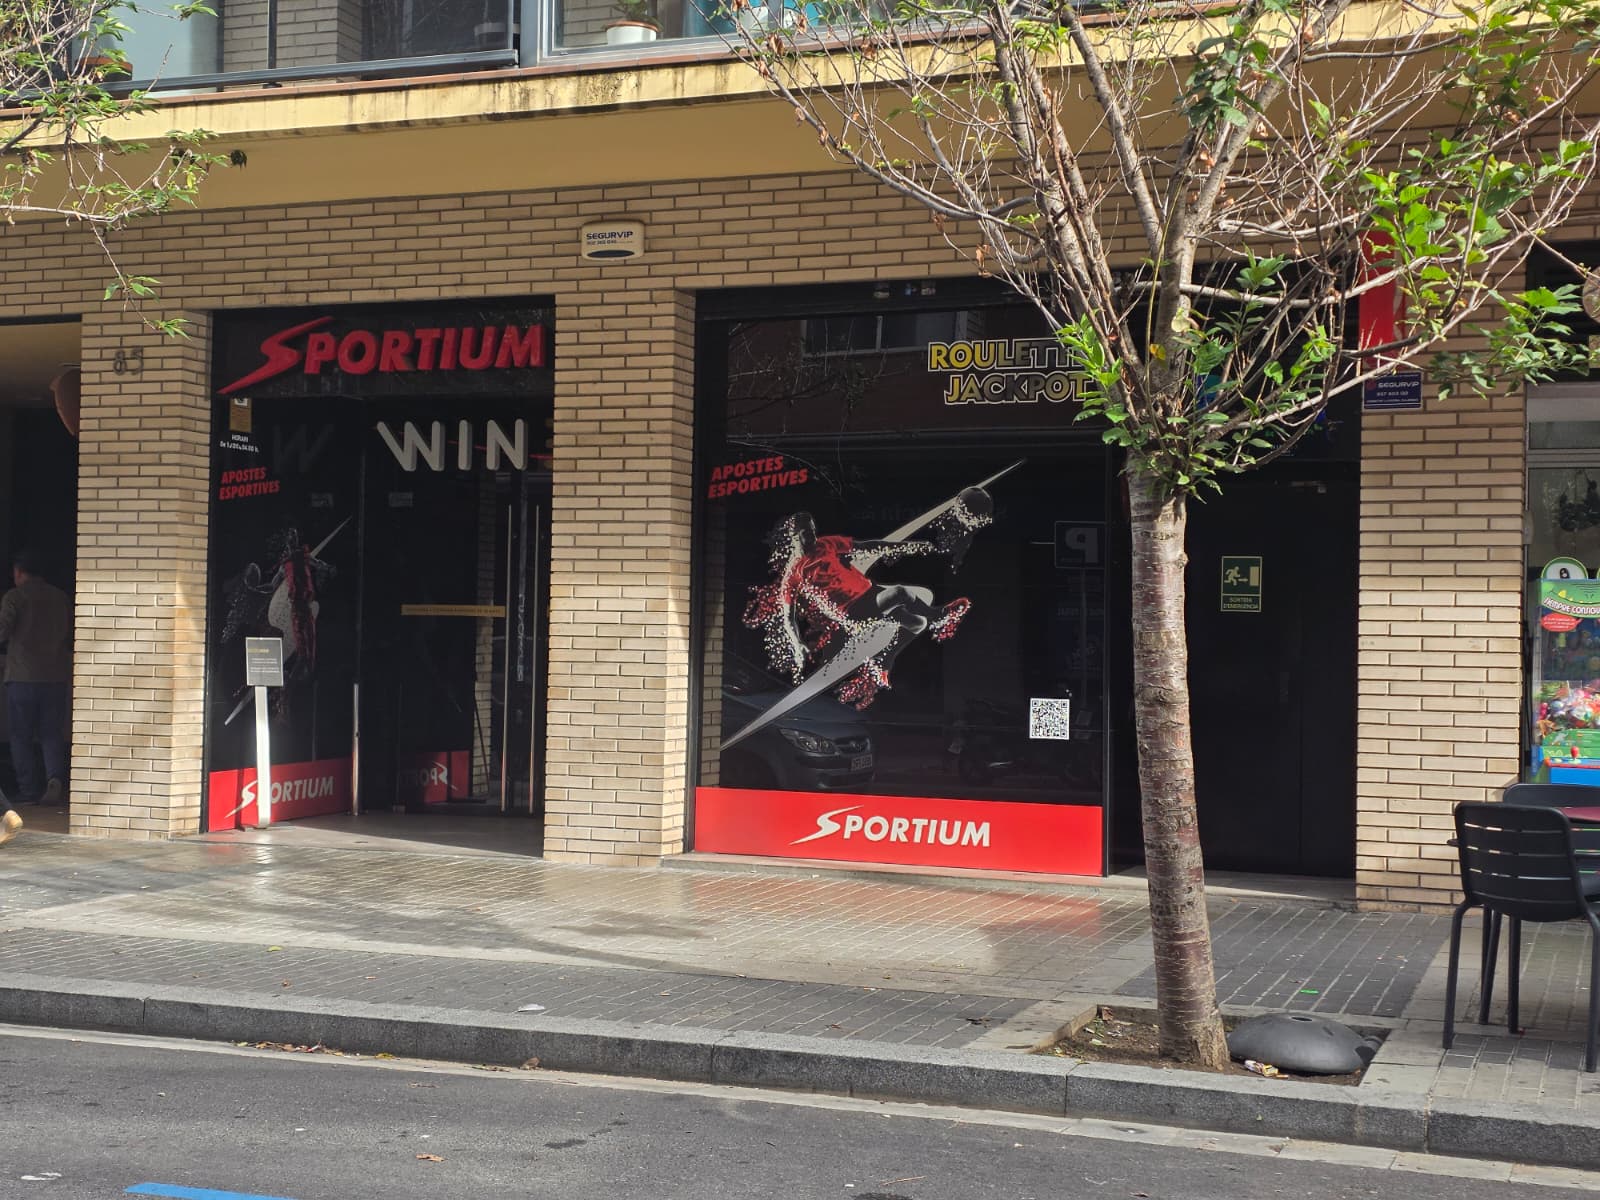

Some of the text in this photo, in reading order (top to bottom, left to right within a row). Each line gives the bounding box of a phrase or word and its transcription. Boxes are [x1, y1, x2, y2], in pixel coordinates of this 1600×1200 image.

[113, 345, 144, 376] 85
[217, 316, 545, 394] SPORTIUM
[944, 371, 1095, 405] JACKPOT
[376, 418, 527, 471] WIN
[222, 467, 266, 484] APOSTES
[708, 469, 808, 498] ESPORTIVES
[711, 456, 784, 481] APOSTES
[219, 480, 280, 500] ESPORTIVES
[224, 776, 335, 819] SORTIUM
[788, 805, 991, 847] SPORTIUM
